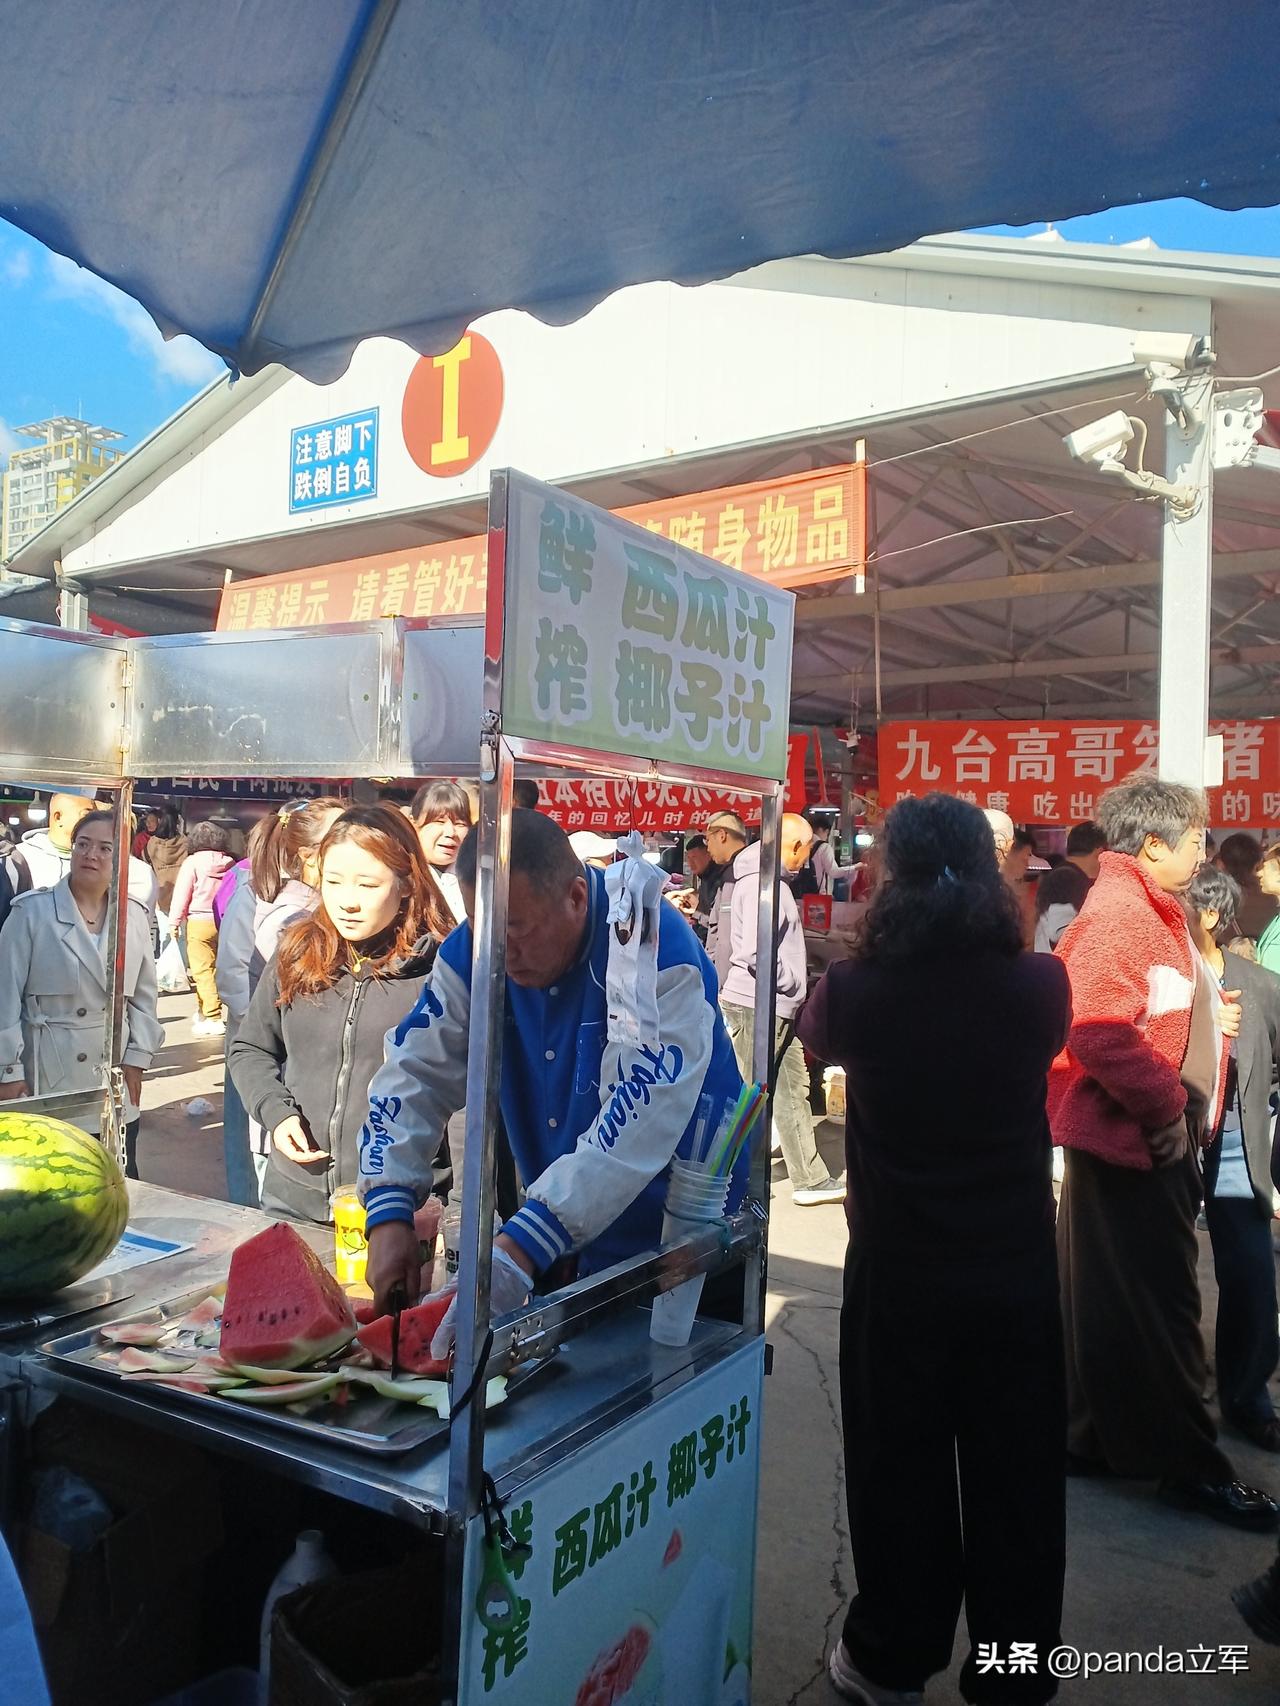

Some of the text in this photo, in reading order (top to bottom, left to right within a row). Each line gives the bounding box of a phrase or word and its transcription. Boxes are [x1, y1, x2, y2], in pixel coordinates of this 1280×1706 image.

[294, 456, 372, 501] 跌倒自负
[295, 419, 374, 465] 注意脚下
[638, 484, 850, 573] 随身物品
[228, 579, 330, 631] 温馨提示
[621, 540, 776, 671] 西瓜汁
[615, 639, 773, 754] 椰子汁
[552, 1395, 752, 1597] 西瓜汁 椰子汁
